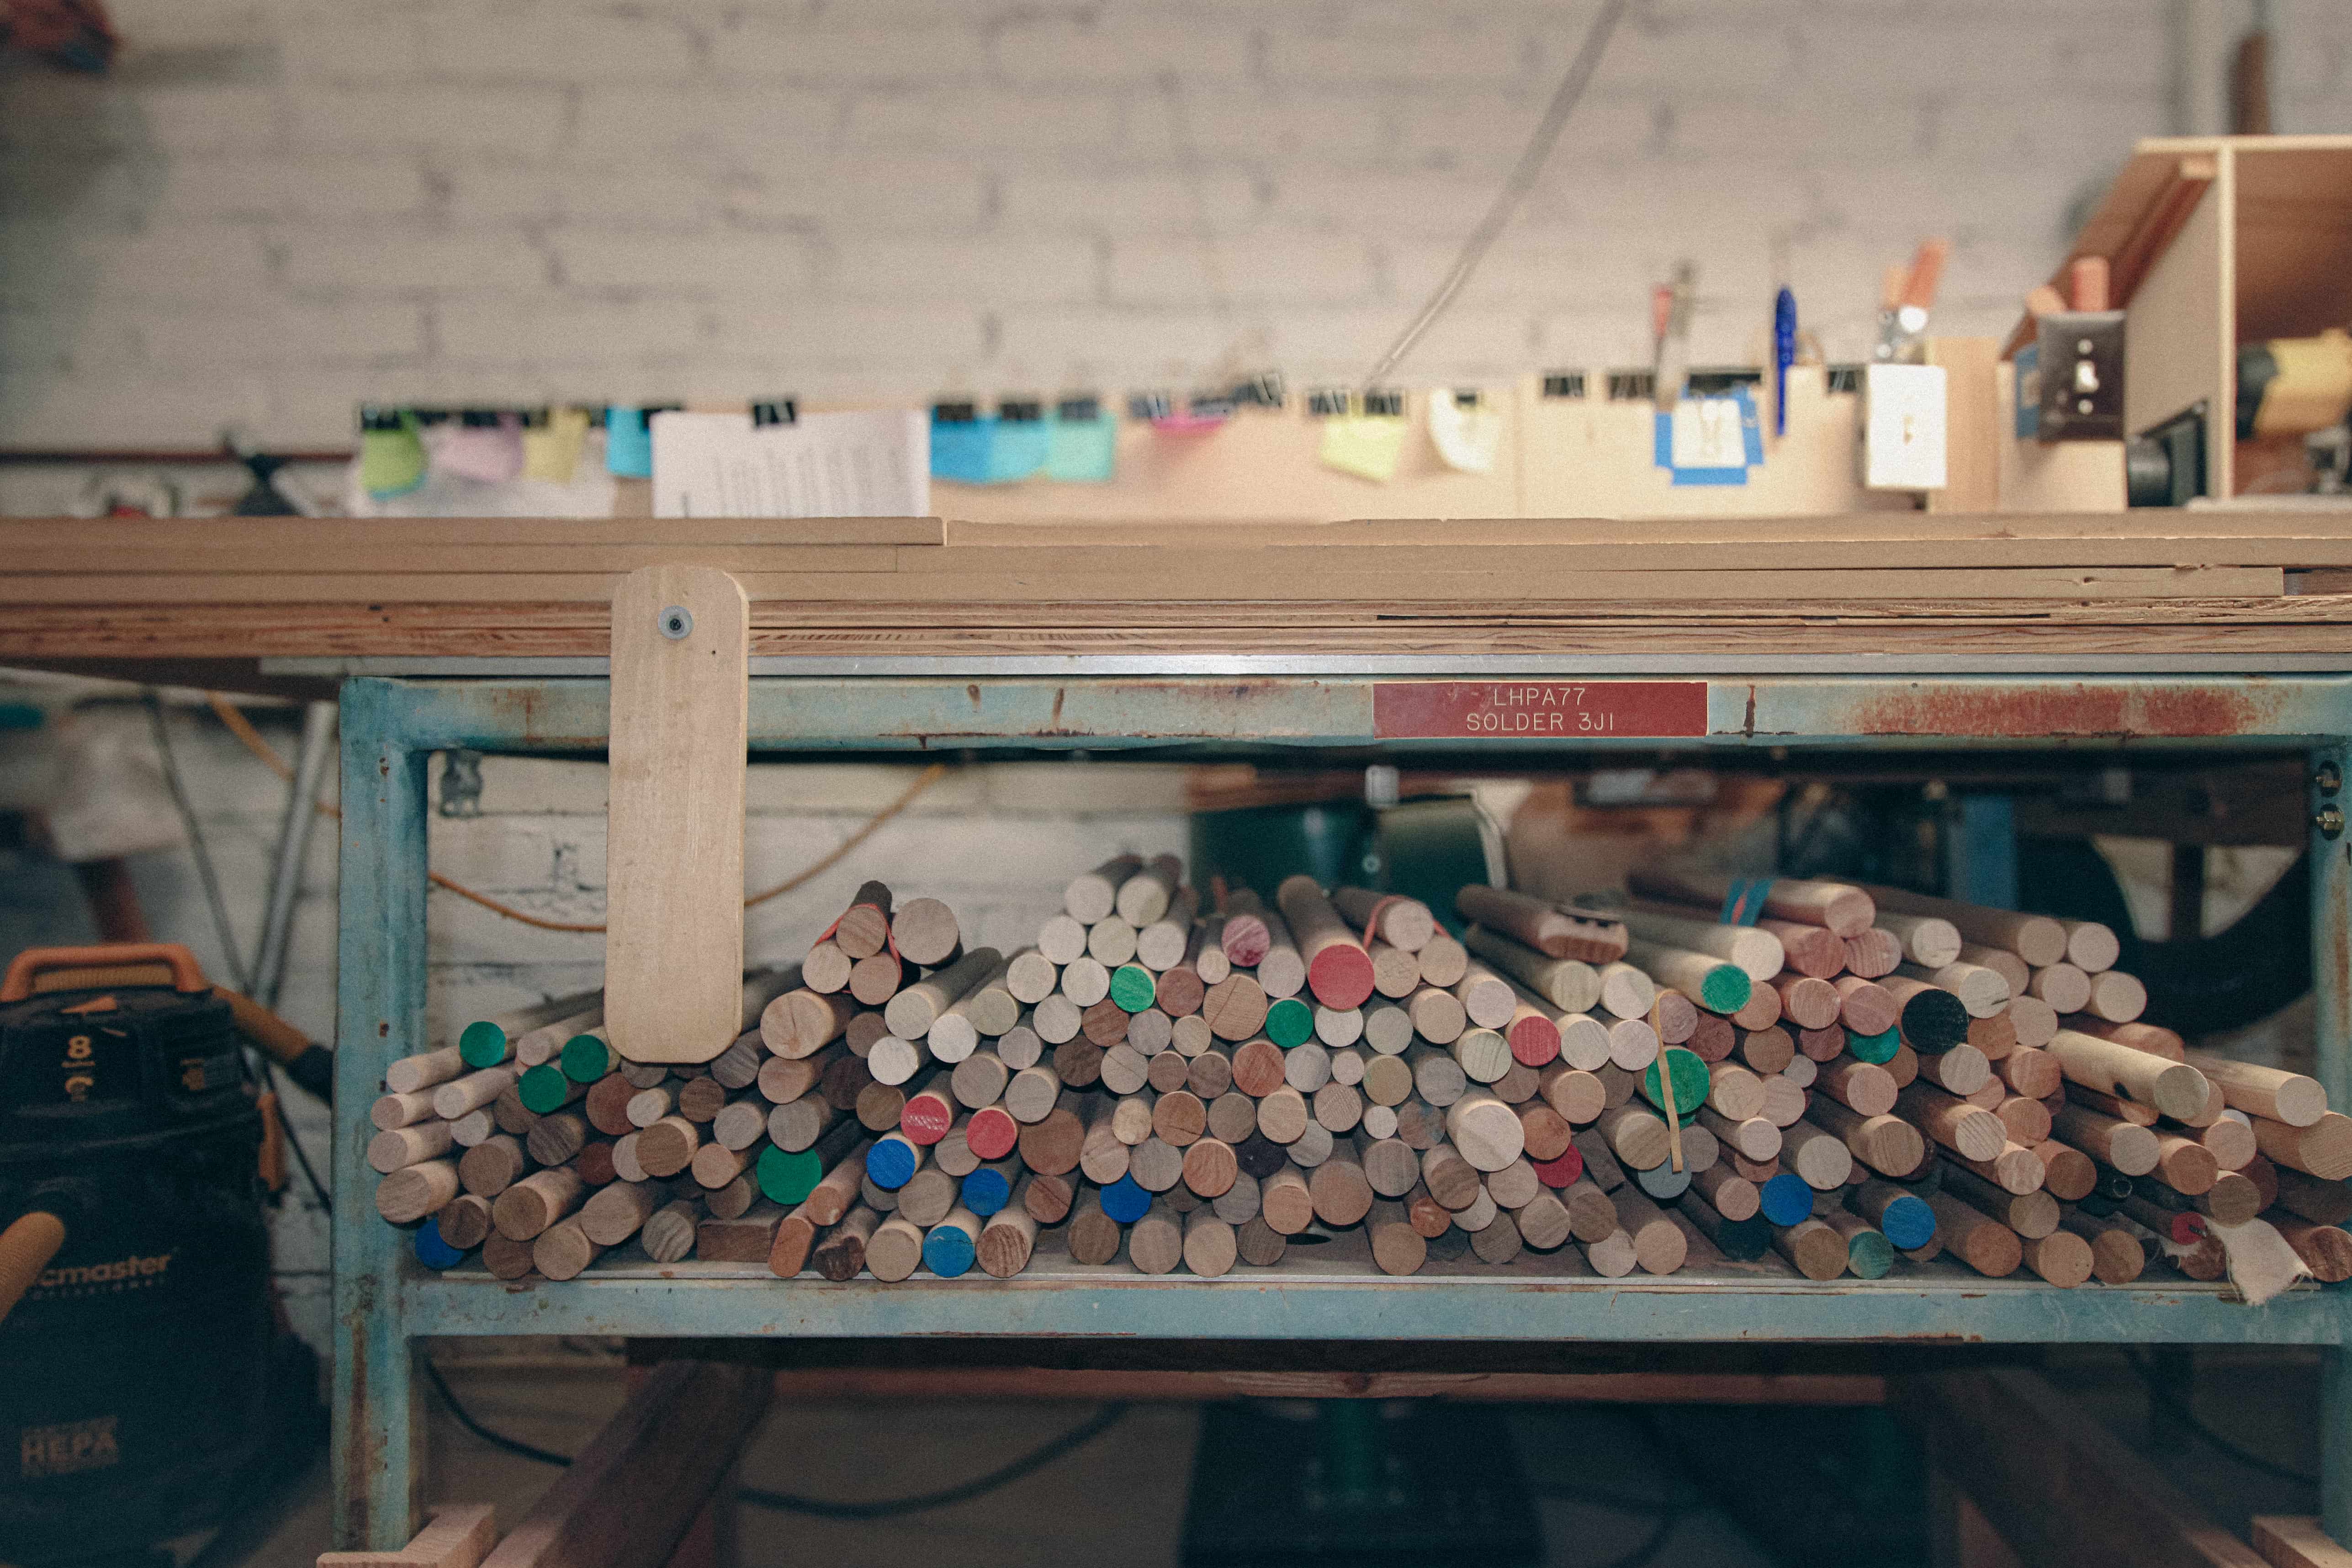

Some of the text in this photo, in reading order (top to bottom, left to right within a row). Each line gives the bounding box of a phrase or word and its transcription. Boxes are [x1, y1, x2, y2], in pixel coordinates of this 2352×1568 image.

[1494, 688, 1585, 706] LHPA77
[1467, 713, 1563, 731] SOLDER
[68, 1035, 92, 1059] 8
[39, 1255, 172, 1287] cmaster
[21, 1431, 119, 1464] HEPA
